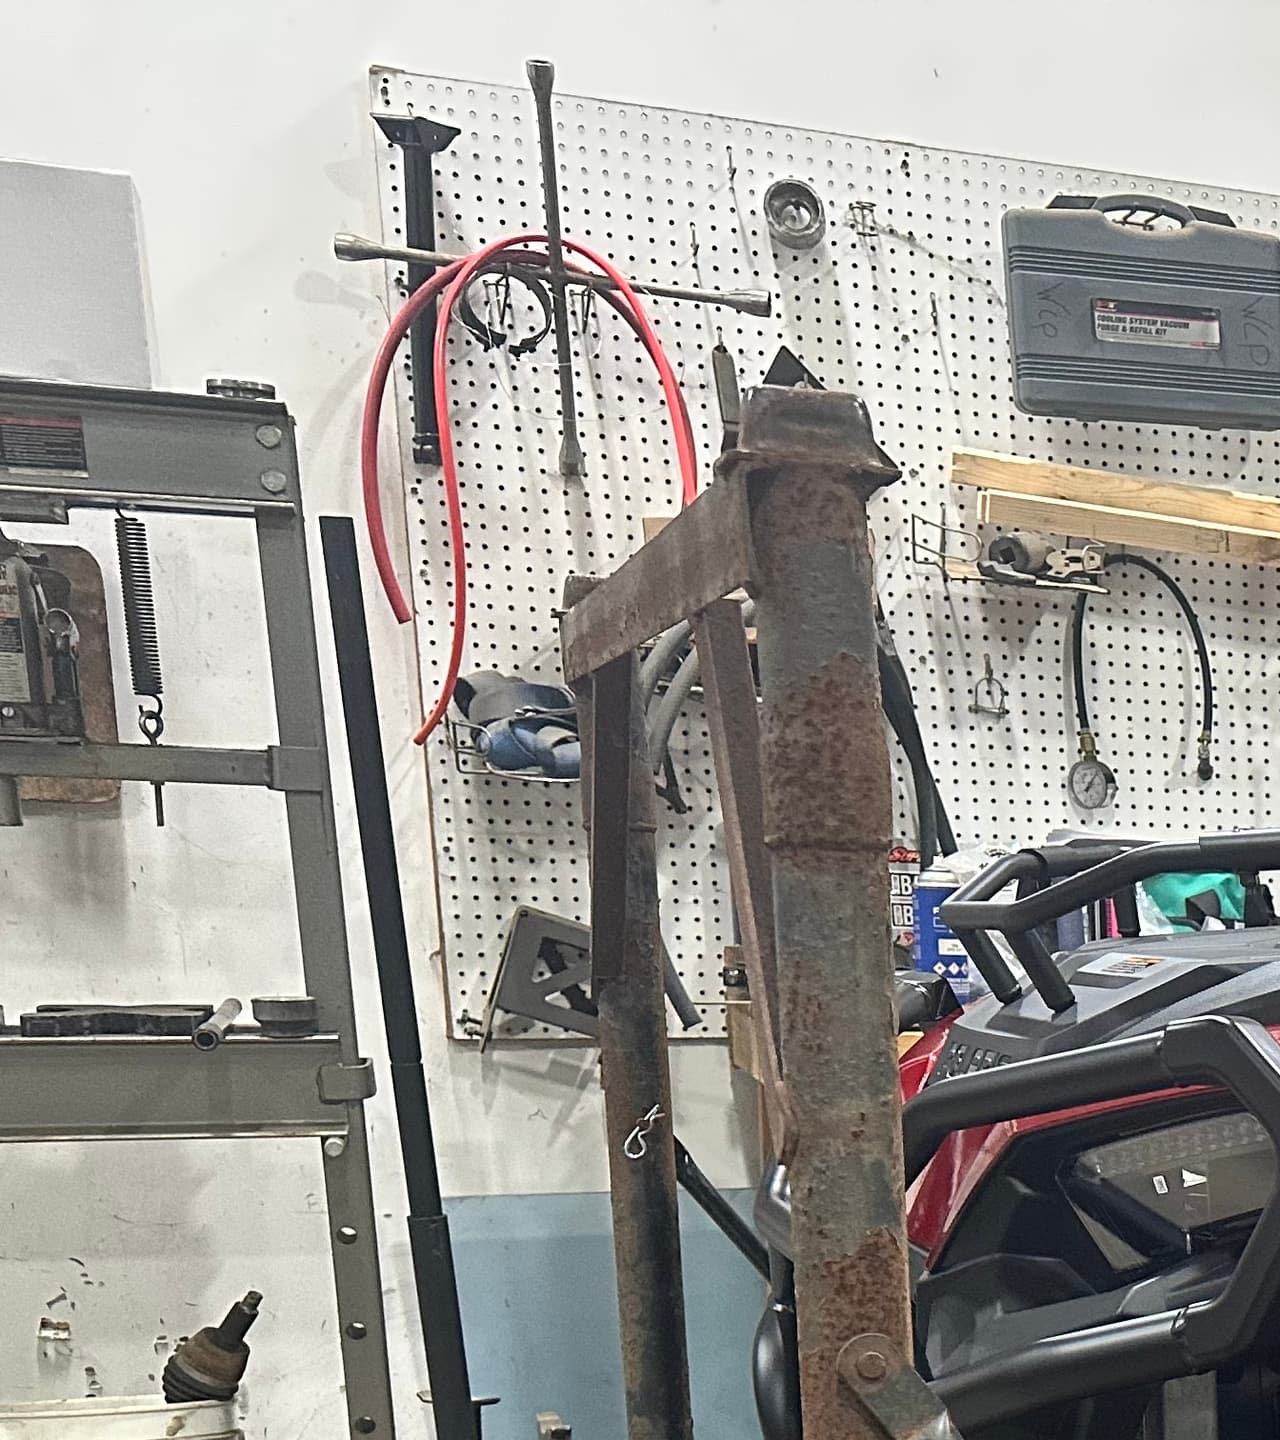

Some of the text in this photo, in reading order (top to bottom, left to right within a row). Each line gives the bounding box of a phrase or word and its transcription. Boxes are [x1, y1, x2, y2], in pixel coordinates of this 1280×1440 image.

[1129, 317, 1158, 327] SYSTEM
[1160, 319, 1190, 329] VACUUM
[1129, 326, 1153, 336] REFILL
